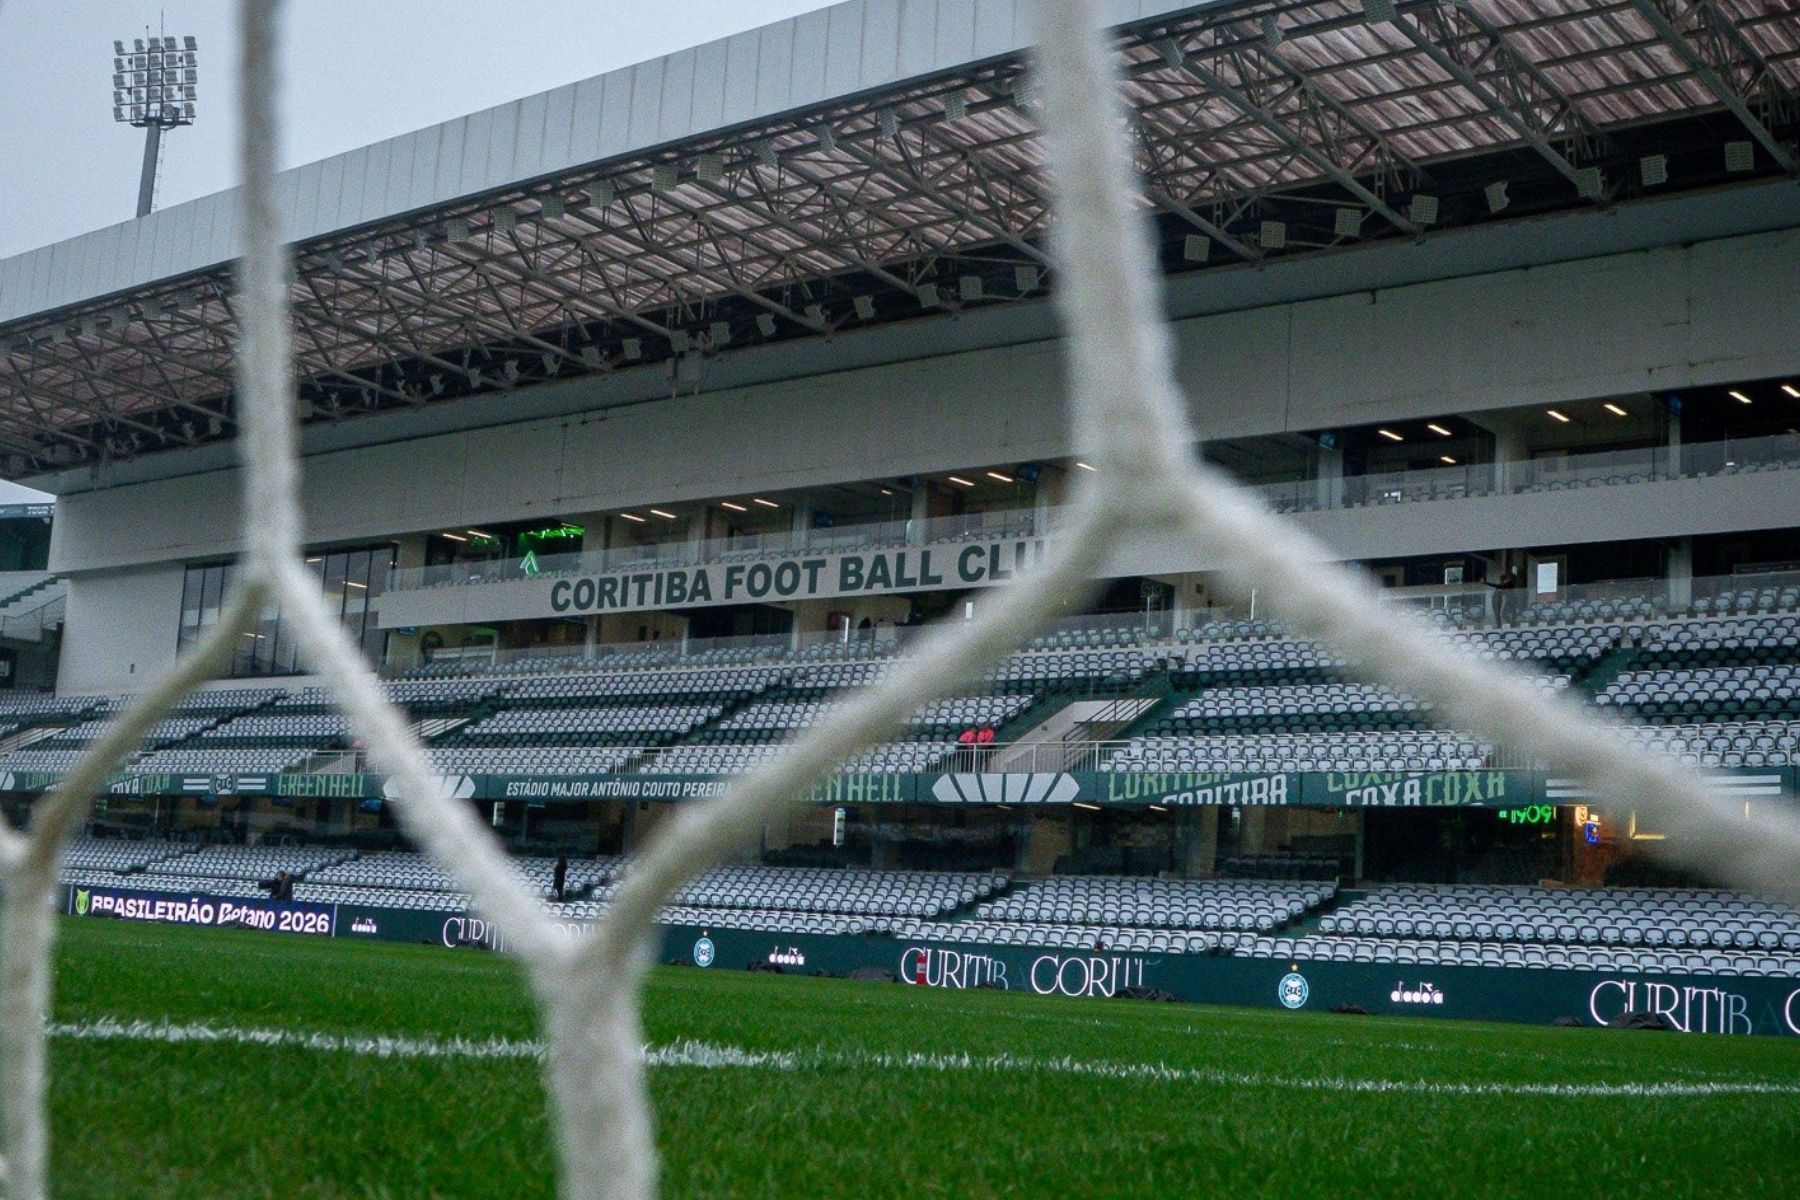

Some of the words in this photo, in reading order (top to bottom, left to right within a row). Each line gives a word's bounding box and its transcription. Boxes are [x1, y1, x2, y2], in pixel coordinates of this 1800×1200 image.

[551, 569, 713, 612] CORITIBA
[724, 558, 827, 599] FOOT
[838, 551, 943, 592] BALL
[957, 541, 1045, 583] CLU
[277, 774, 326, 797] GREEN
[329, 774, 365, 798] HELL
[506, 778, 550, 797] ESTÁDIO
[551, 782, 588, 797] MAJOR
[591, 778, 640, 797] ANTÔNIO
[642, 782, 680, 798] COUTO
[91, 895, 214, 924] BRASILEIRÃO
[279, 911, 330, 933] 2026
[901, 947, 1009, 991] CURITIB
